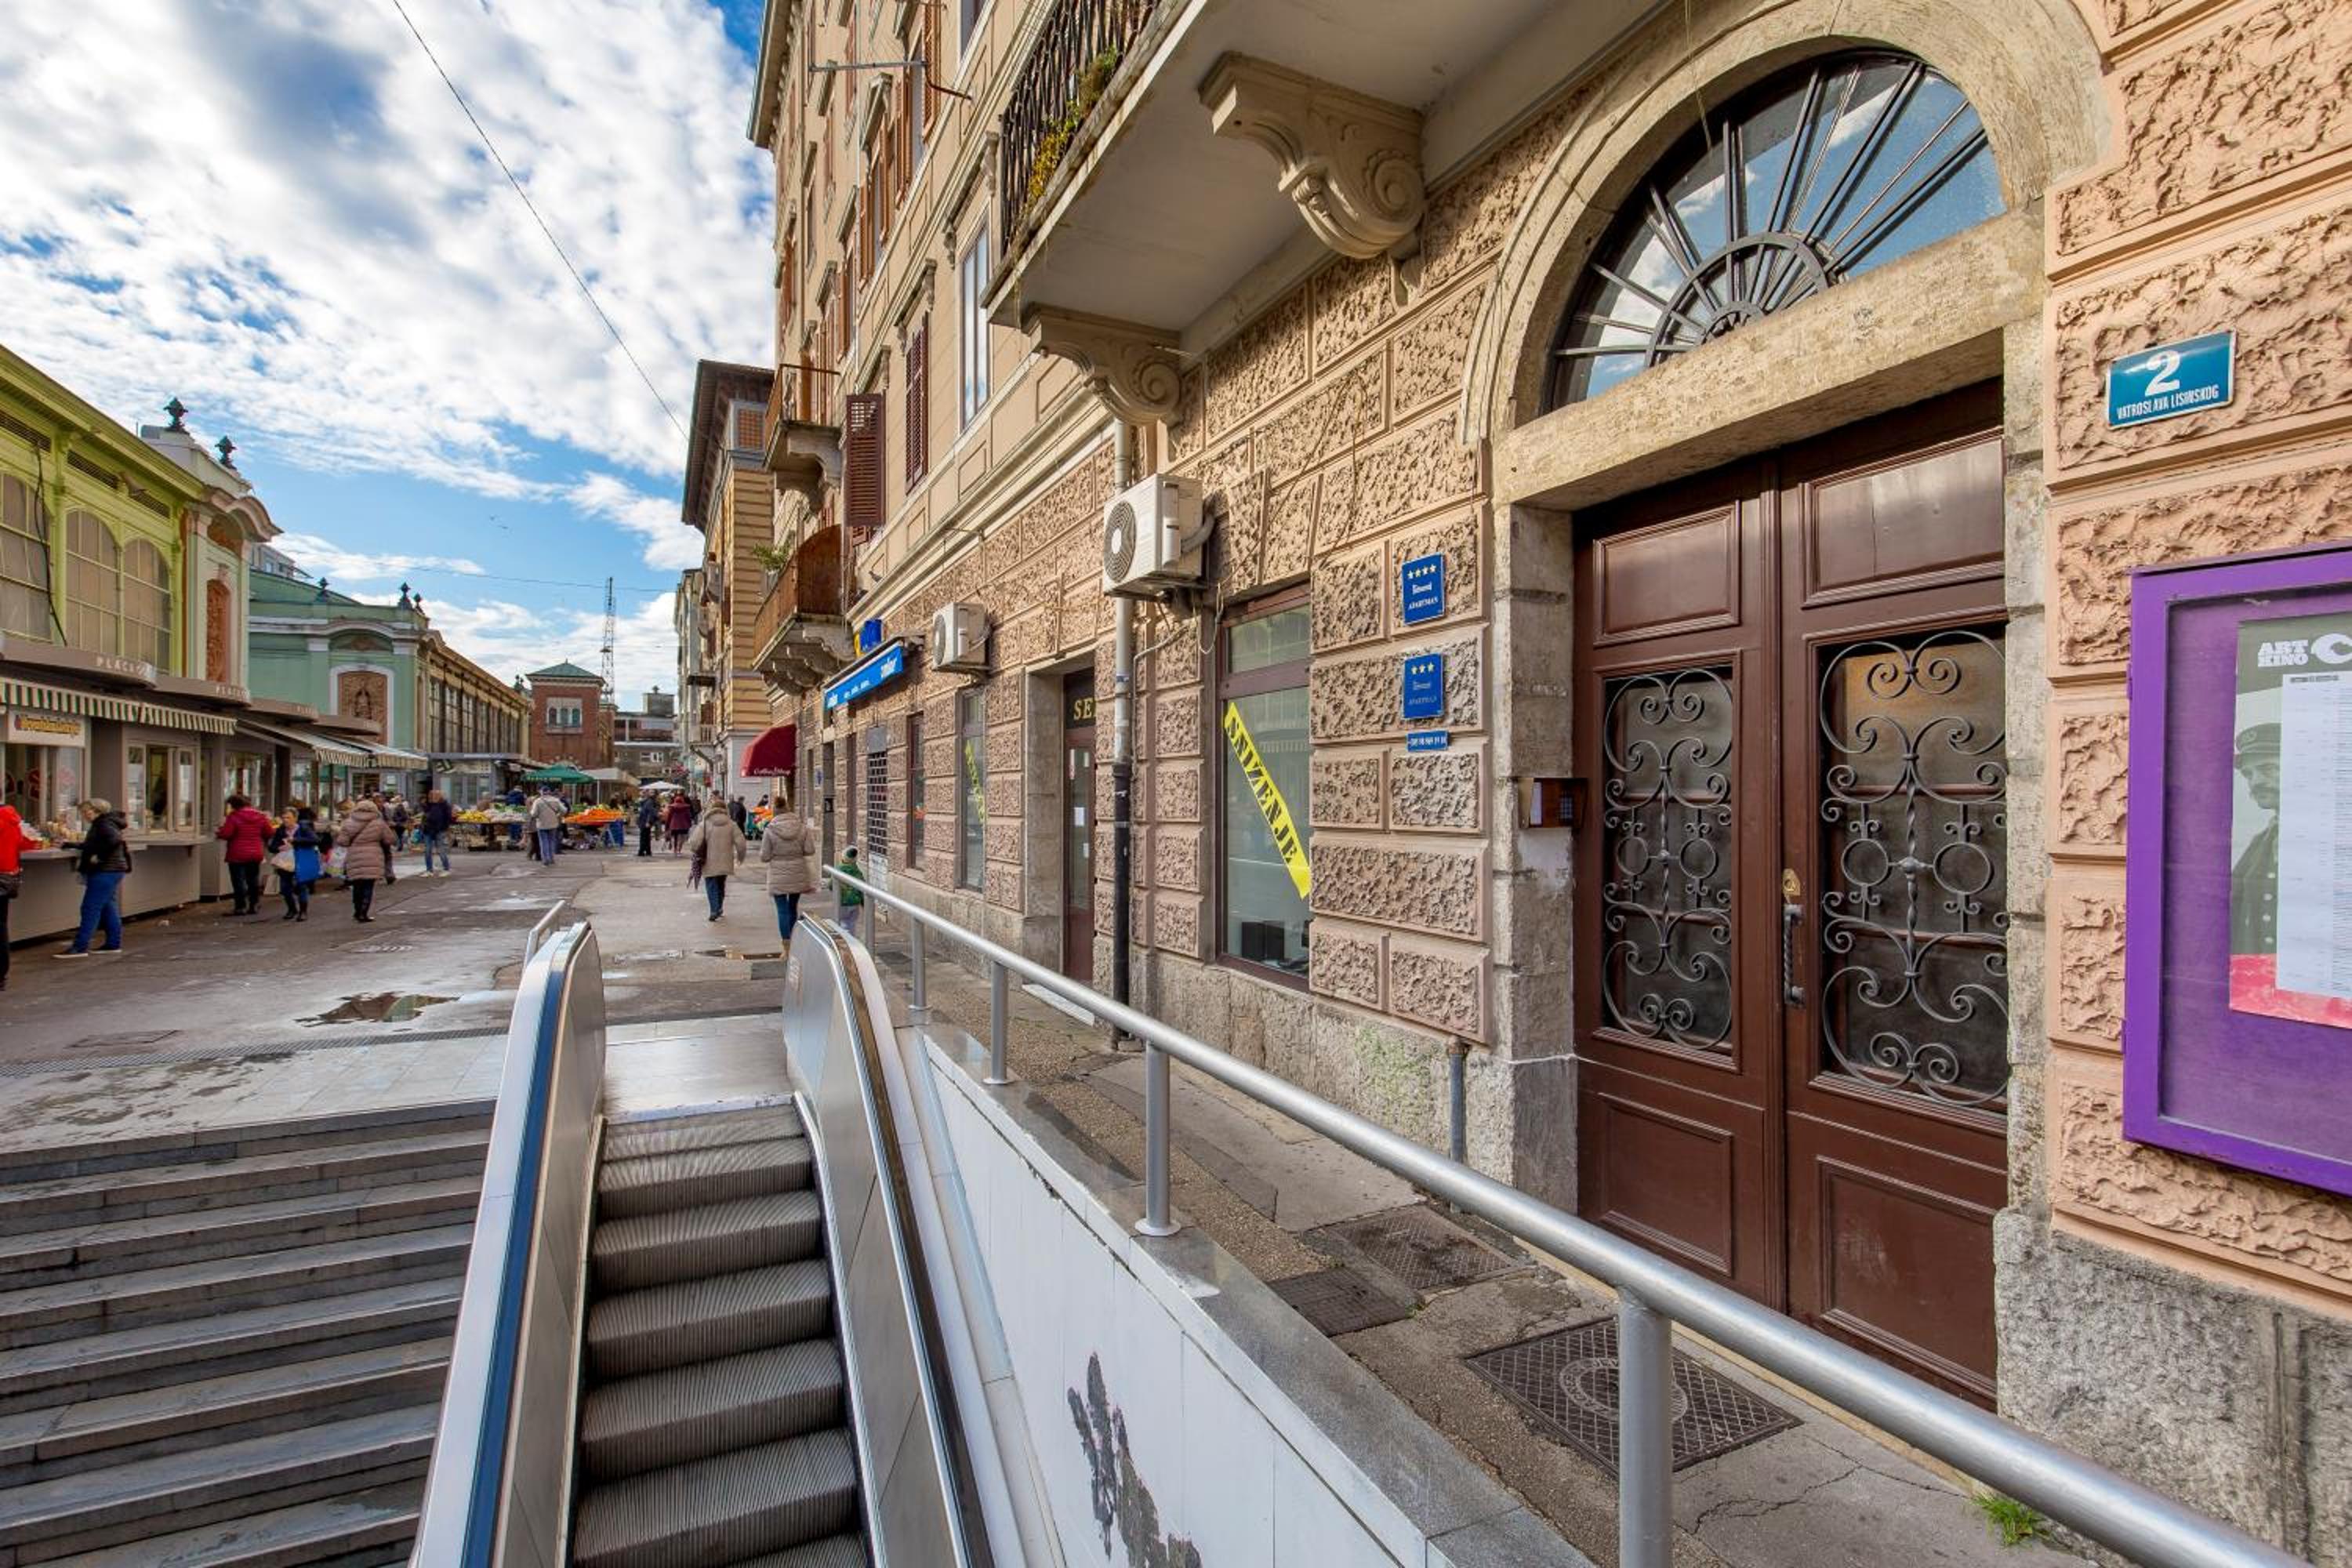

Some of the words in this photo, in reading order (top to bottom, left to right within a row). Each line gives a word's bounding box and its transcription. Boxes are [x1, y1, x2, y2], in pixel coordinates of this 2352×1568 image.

[2144, 350, 2180, 397] 2
[2116, 397, 2169, 419] VATROSLAVA
[2170, 385, 2220, 408] LISINSKOG
[2259, 639, 2309, 654] ART
[2258, 653, 2309, 667] KINO
[1073, 698, 1096, 720] SE
